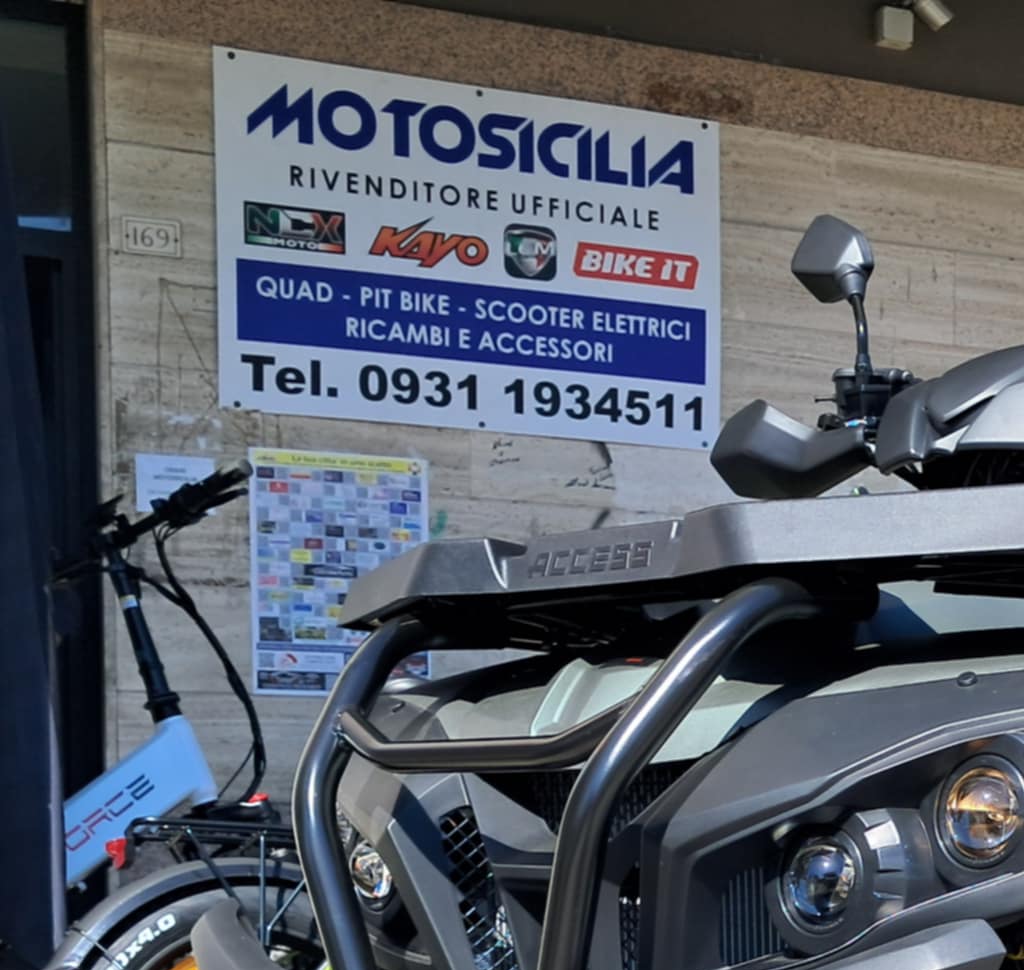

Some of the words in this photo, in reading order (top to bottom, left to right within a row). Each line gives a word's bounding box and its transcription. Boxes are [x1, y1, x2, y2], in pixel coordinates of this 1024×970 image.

[246, 83, 695, 195] MOTOSICILIA
[289, 165, 498, 211] RIVENDITORE
[511, 193, 660, 231] UFFICIALE
[132, 226, 170, 249] 169
[580, 249, 655, 279] BIKE
[660, 258, 693, 283] IT
[256, 276, 333, 303] QUAD
[360, 286, 392, 309] PIT
[400, 290, 450, 316] BIKE
[474, 298, 585, 330] SCOOTER
[592, 311, 691, 341] ELETTRICI
[345, 317, 450, 347] RICAMBI
[458, 329, 471, 349] E
[478, 330, 613, 363] ACCESSORI
[240, 354, 338, 398] Tel.
[359, 364, 478, 410] 0931
[504, 378, 703, 431] 1934511
[528, 540, 655, 579] ACCESS
[65, 773, 155, 851] ORCE
